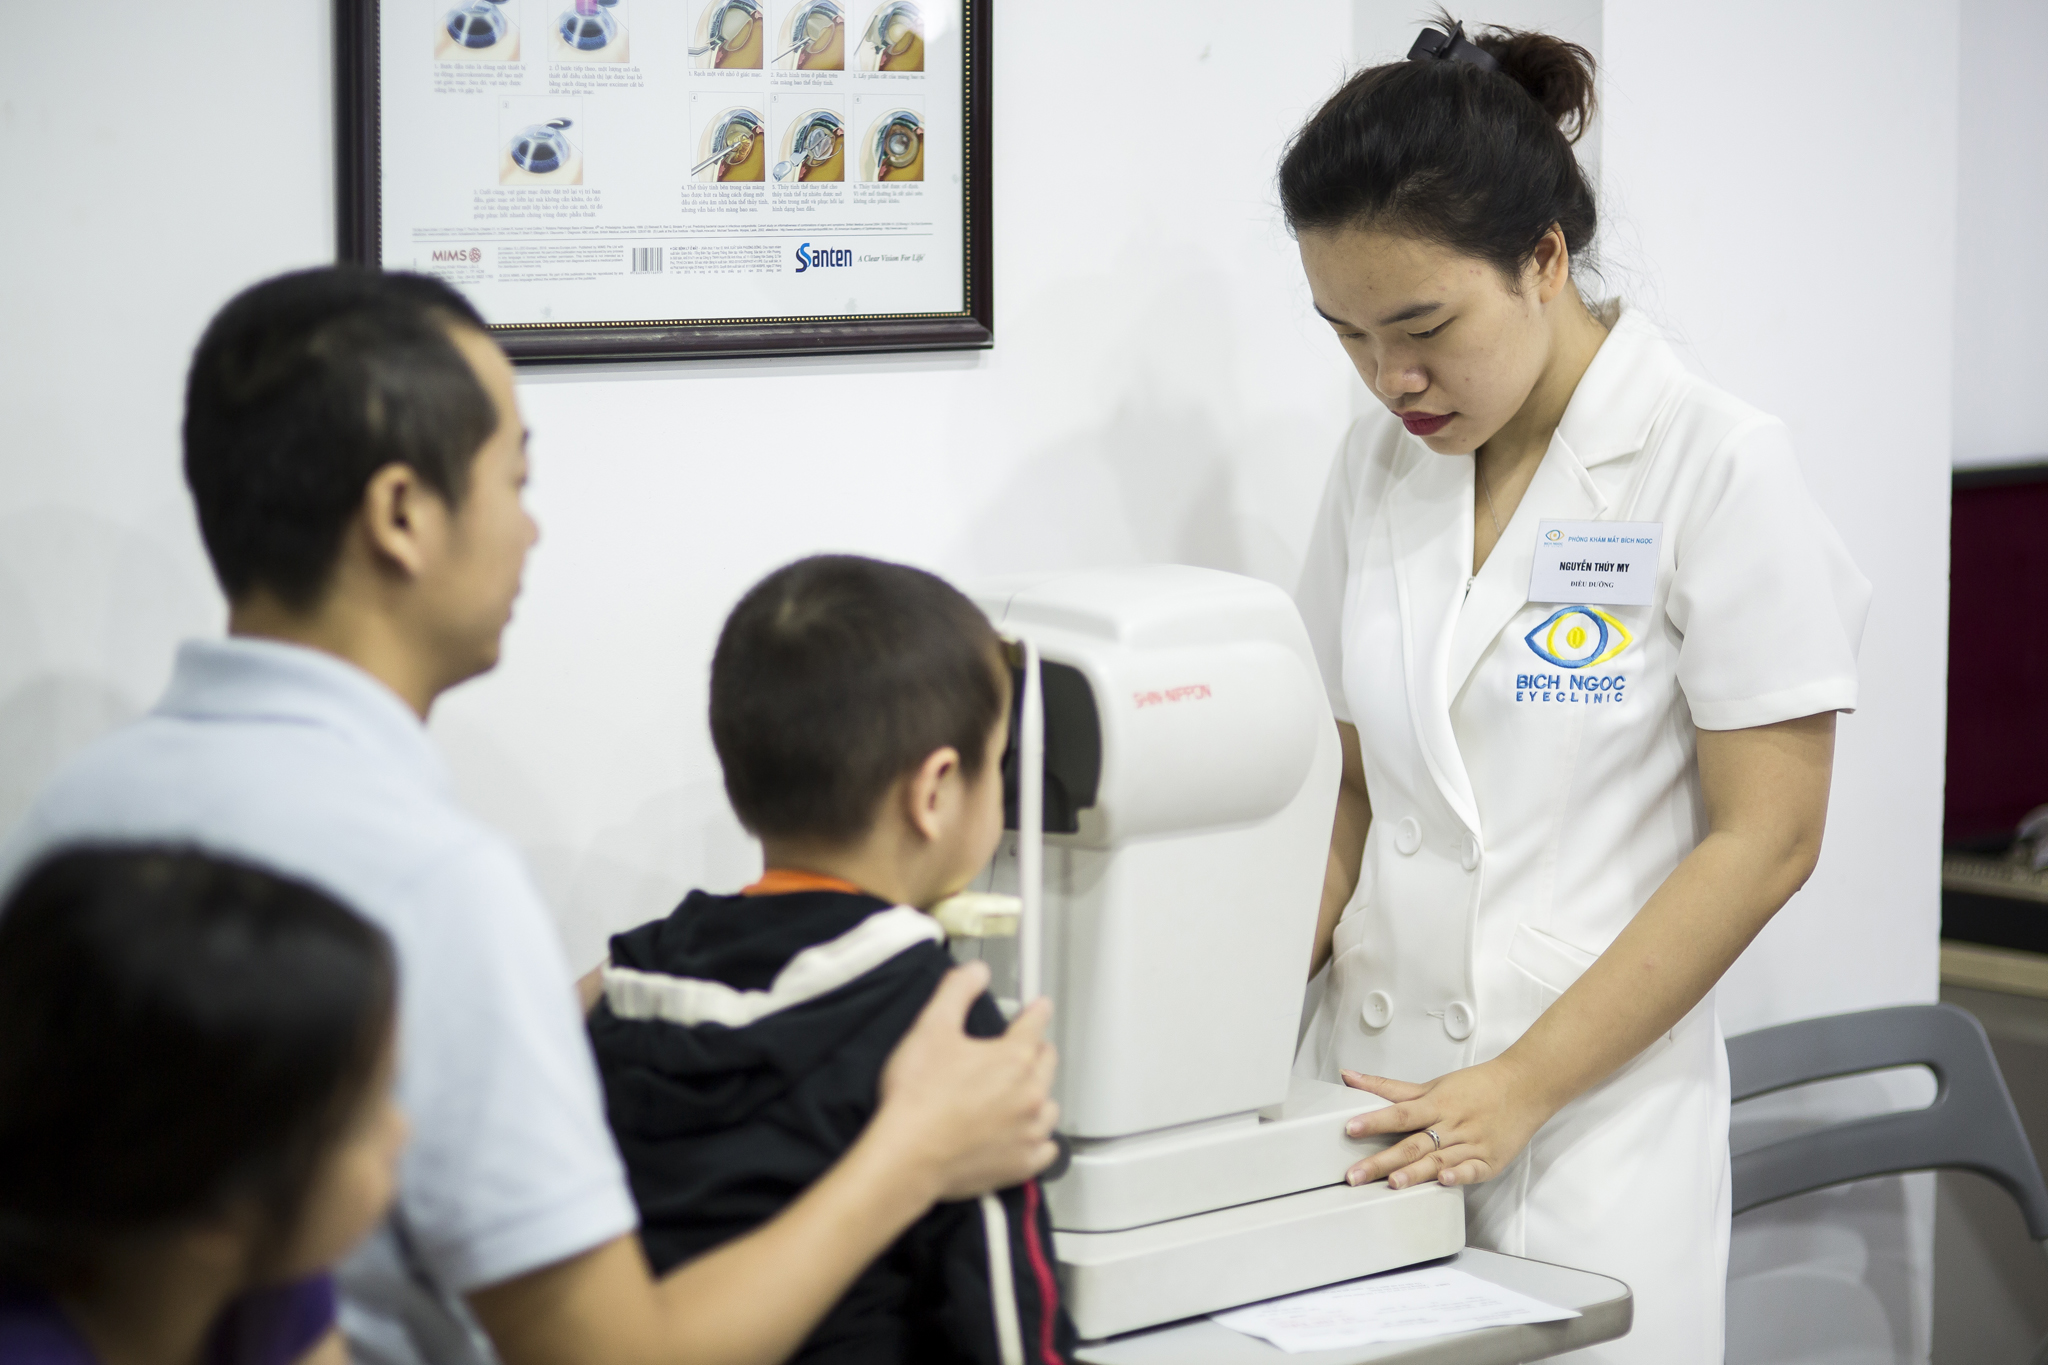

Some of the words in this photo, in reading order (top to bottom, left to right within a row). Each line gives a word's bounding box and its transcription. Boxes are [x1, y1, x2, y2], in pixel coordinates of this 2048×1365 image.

[432, 250, 467, 261] MIMS
[795, 242, 853, 273] Santen
[858, 254, 863, 262] A
[863, 254, 881, 262] Clear
[881, 254, 899, 262] Vision
[900, 253, 911, 261] For
[912, 253, 925, 263] Life
[1616, 563, 1630, 573] MY
[1517, 674, 1560, 690] BICH
[1570, 674, 1626, 691] NGOC
